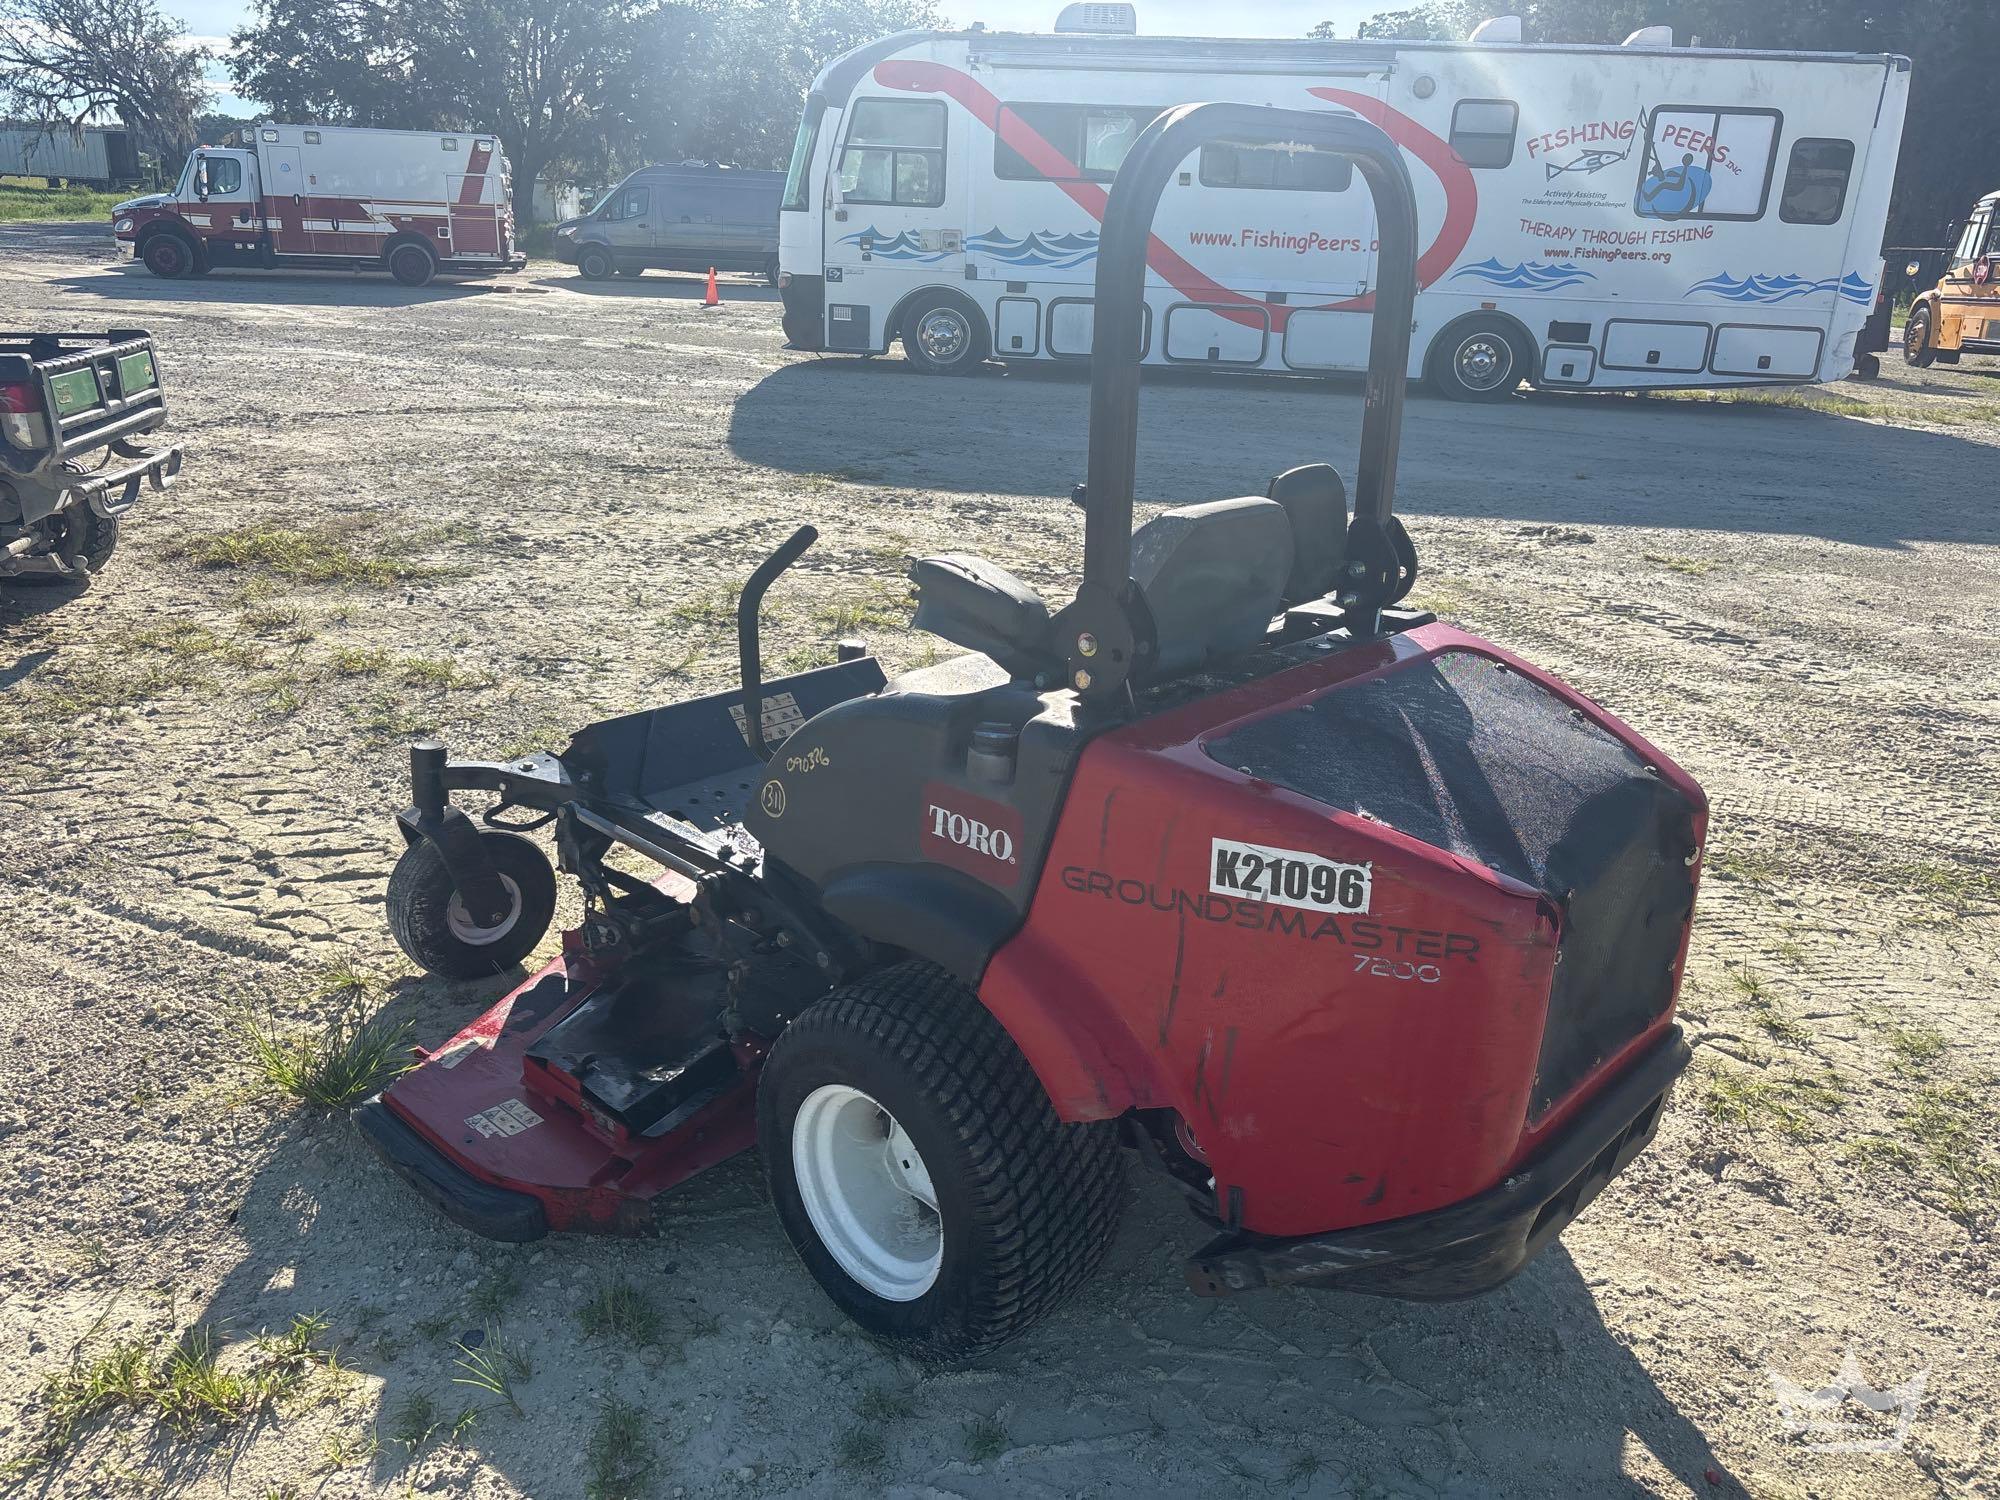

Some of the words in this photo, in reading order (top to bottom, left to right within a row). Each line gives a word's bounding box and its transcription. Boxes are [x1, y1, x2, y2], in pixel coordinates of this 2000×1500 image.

[1527, 120, 1635, 159] FISHING
[1661, 124, 1730, 163] PEERS
[1725, 160, 1742, 176] INC
[1543, 190, 1573, 199] Actively
[1574, 190, 1608, 200] Assisting
[1520, 218, 1577, 241] THERAPY
[1582, 229, 1647, 245] THROUGH
[1651, 224, 1714, 245] FISHING
[1544, 246, 1672, 264] www.FishingPeers.org
[1215, 848, 1364, 910] K21096
[1061, 865, 1481, 963] GROUNDSMASTER
[1352, 953, 1441, 984] 7200
